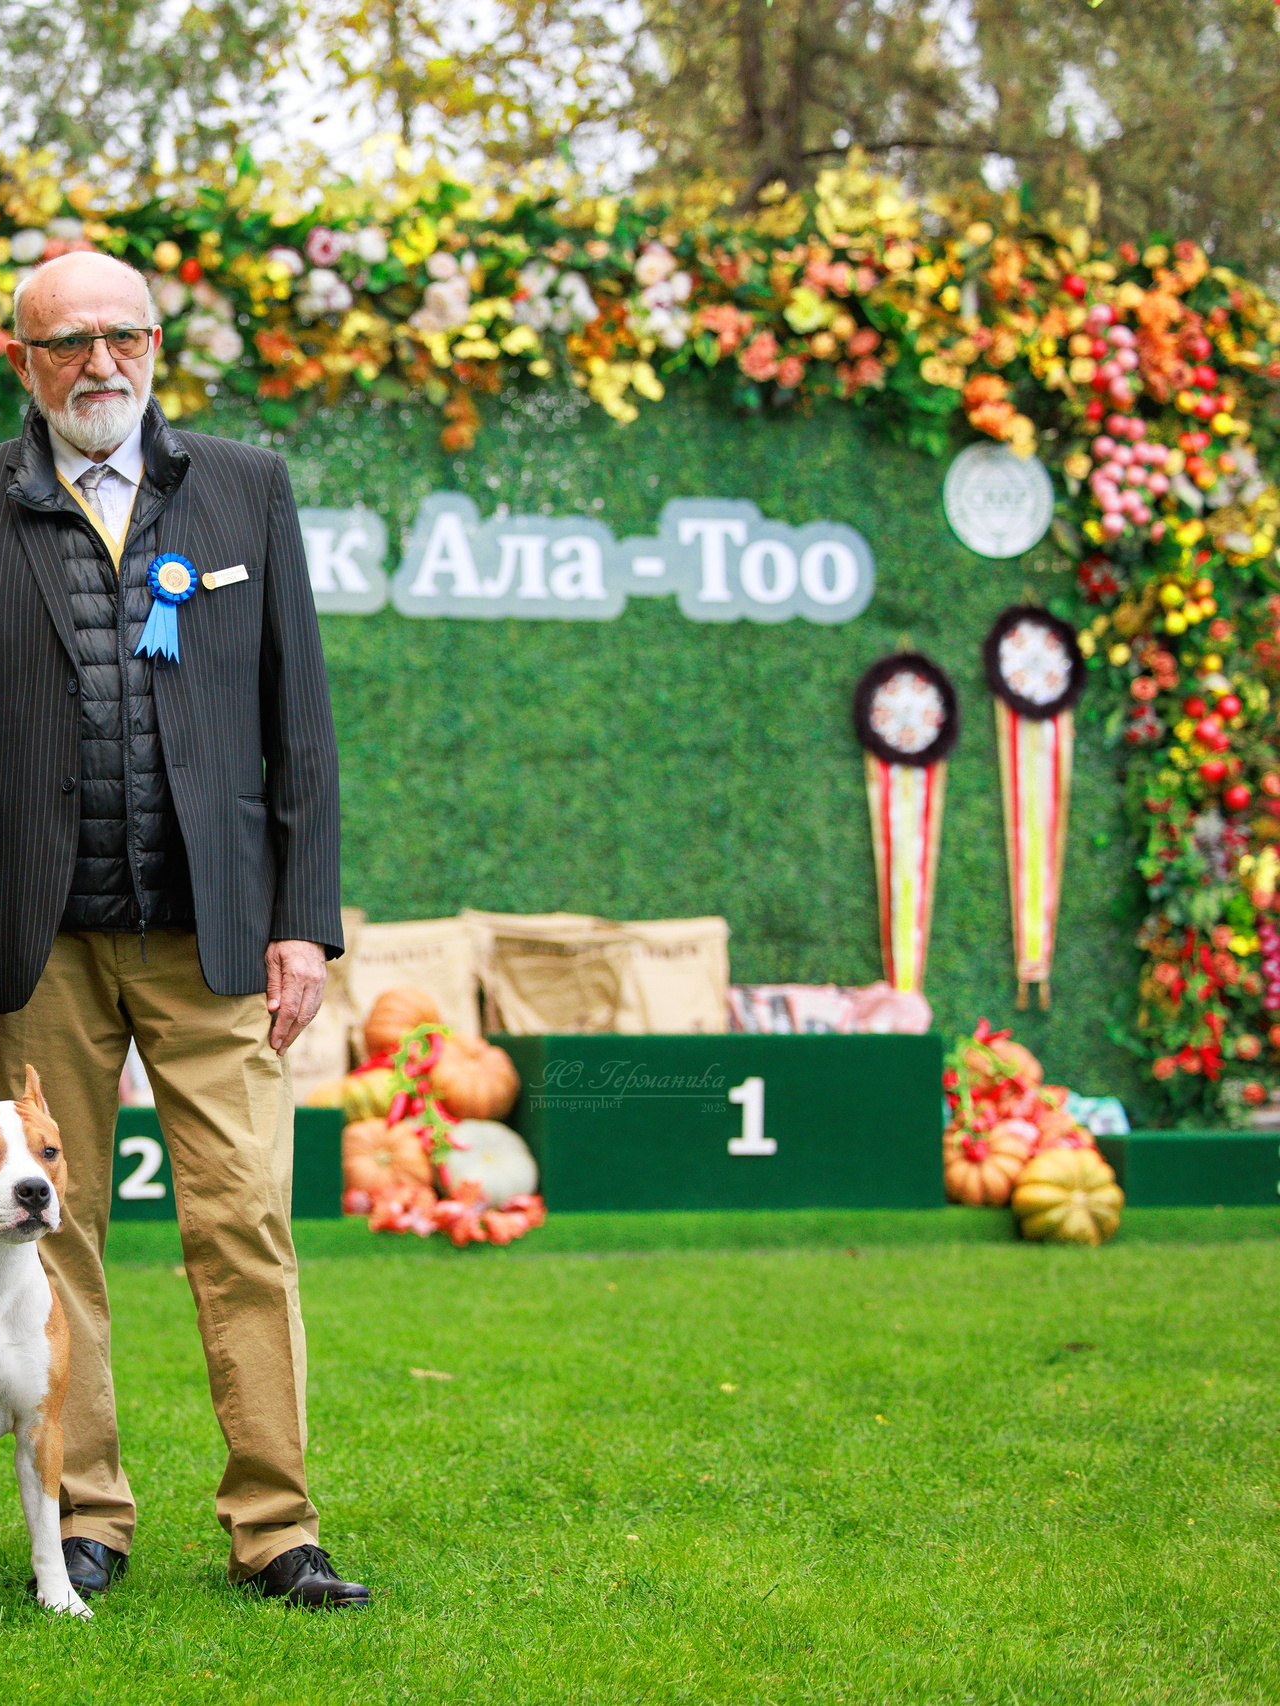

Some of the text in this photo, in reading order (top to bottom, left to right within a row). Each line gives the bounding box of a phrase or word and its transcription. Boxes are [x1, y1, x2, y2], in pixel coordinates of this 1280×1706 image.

[303, 526, 372, 593] к
[409, 511, 609, 600] Ала
[677, 517, 861, 605] Тоо
[726, 1076, 778, 1156] 1
[118, 1135, 166, 1200] 2
